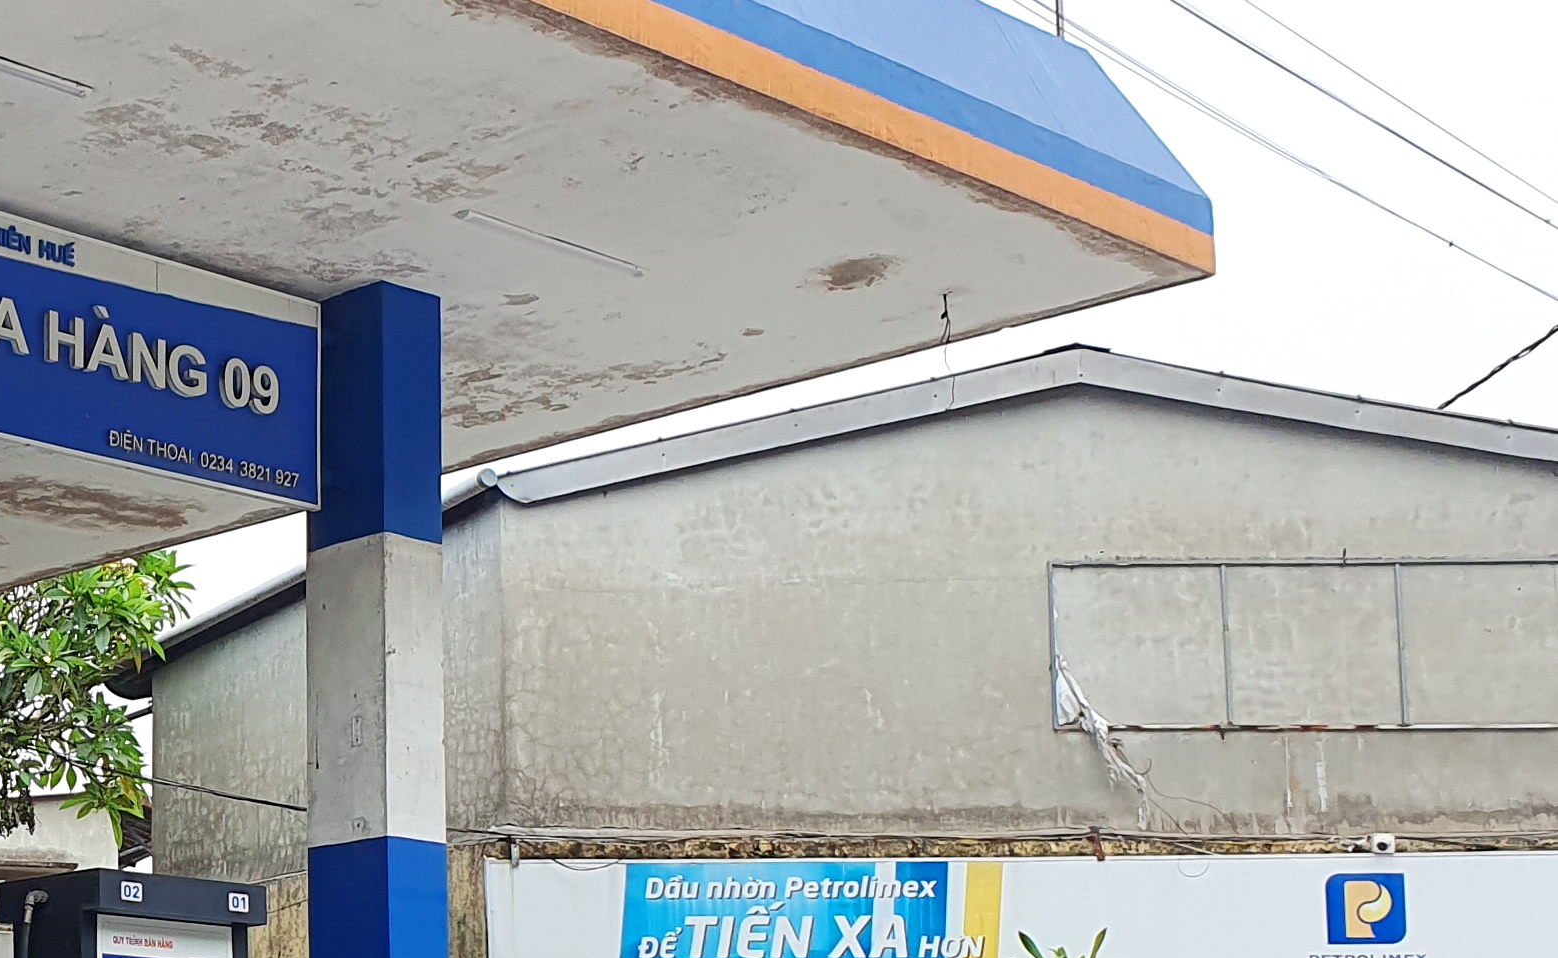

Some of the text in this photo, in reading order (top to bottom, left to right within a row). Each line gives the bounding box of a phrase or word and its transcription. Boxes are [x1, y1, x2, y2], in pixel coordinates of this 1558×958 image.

[45, 304, 208, 397] HÀNG
[220, 356, 280, 414] 09
[108, 429, 143, 453] ĐIỆN
[200, 451, 233, 474] 0234
[240, 460, 270, 482] 3821
[275, 470, 300, 488] 927
[123, 884, 140, 899] 02
[645, 874, 937, 900] Dầu nhờn Petrolimex
[231, 895, 246, 910] 01
